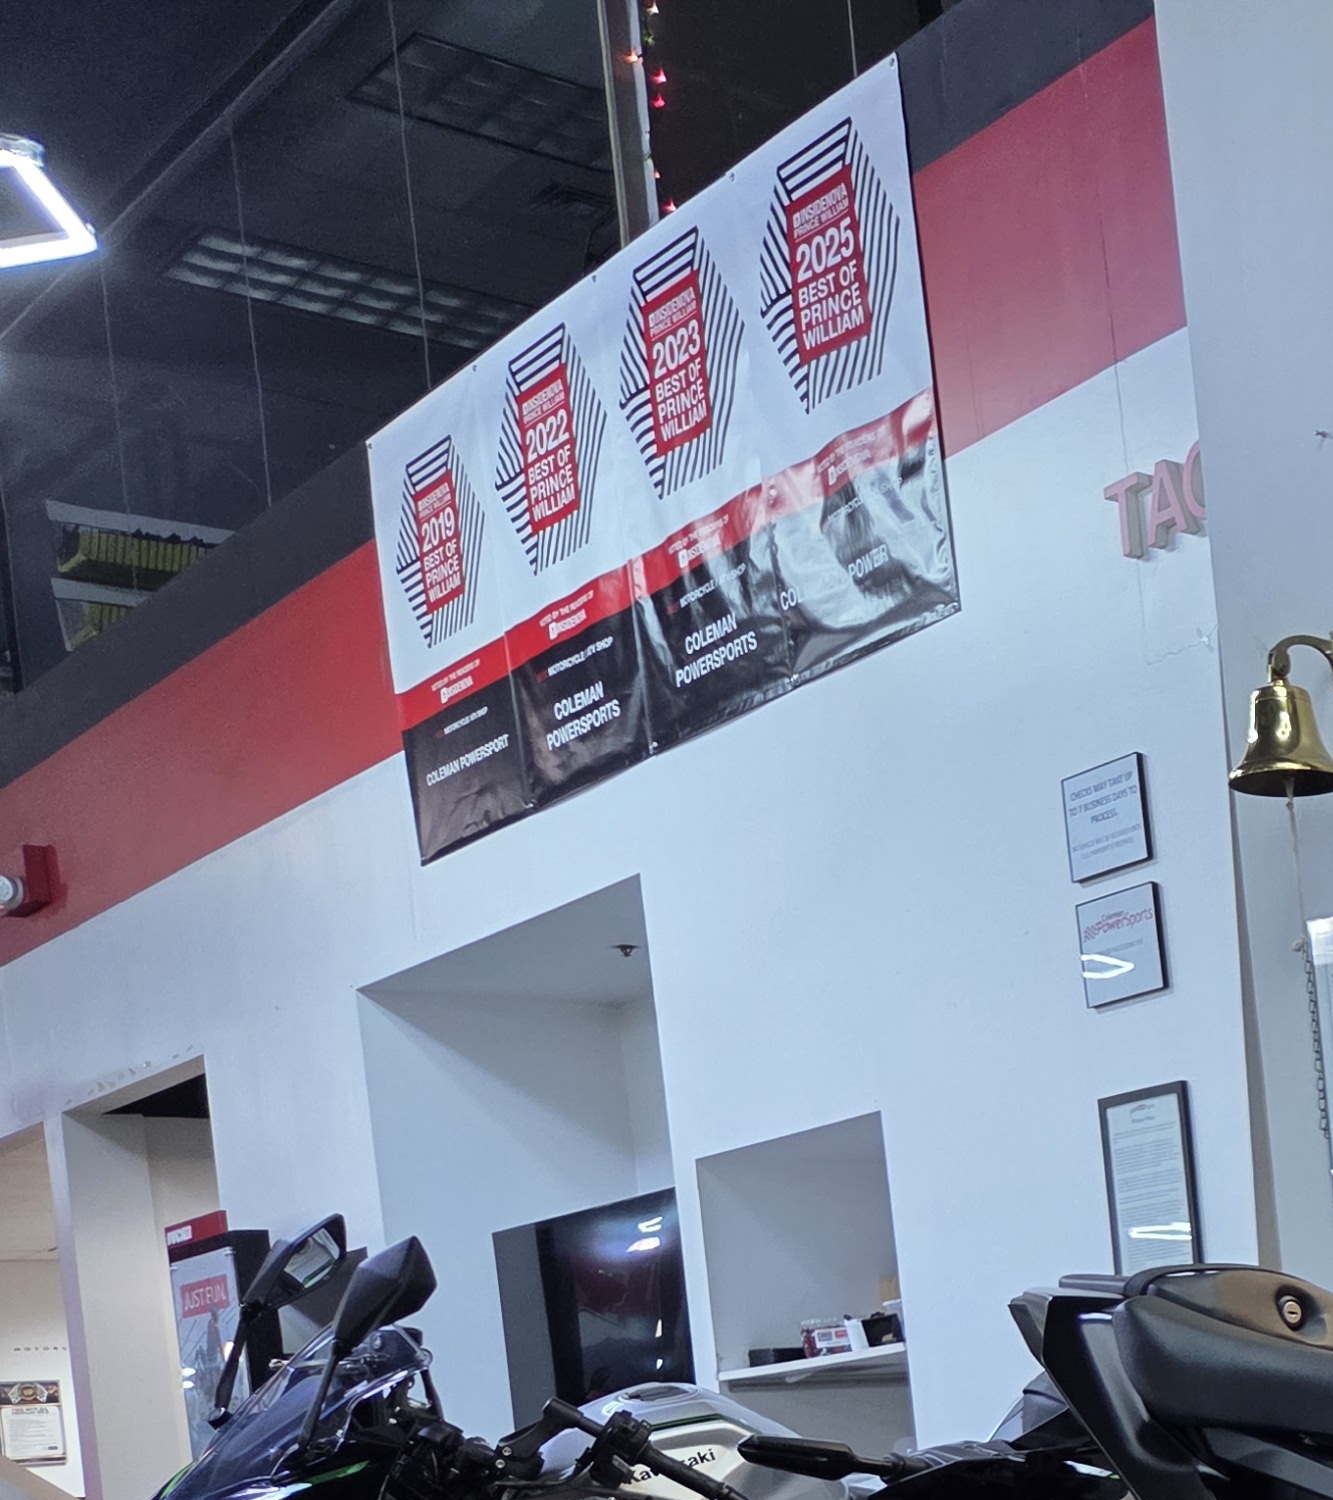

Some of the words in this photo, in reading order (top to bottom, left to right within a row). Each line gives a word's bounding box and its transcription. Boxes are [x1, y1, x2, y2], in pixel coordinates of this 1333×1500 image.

[796, 216, 854, 283] 2025
[798, 272, 836, 308] BEST
[839, 259, 857, 287] OF
[801, 283, 862, 331] PRINCE
[803, 305, 864, 351] WILLIAM
[652, 319, 701, 379] 2023
[655, 369, 686, 402] BEST
[689, 357, 702, 382] OF
[657, 378, 705, 424] PRINCE
[526, 409, 570, 463] 2022
[660, 400, 707, 442] WILLIAM
[528, 455, 554, 485] BEST
[557, 444, 571, 466] OF
[530, 464, 573, 504] PRINCE
[532, 483, 575, 522] WILLIAM
[422, 507, 455, 552] 2019
[423, 548, 444, 571] BEST
[446, 539, 457, 556] OF
[425, 555, 459, 588] PRINCE
[427, 572, 461, 603] WILLIAM
[684, 612, 737, 655] COLEMAN
[675, 631, 758, 688] POWERSPORTS
[554, 681, 604, 720] COLEMAN
[546, 699, 621, 751] POWERSPORTS
[426, 758, 460, 786] COLEMAN
[459, 734, 509, 771] POWERSPORT
[184, 1288, 205, 1311] JUST
